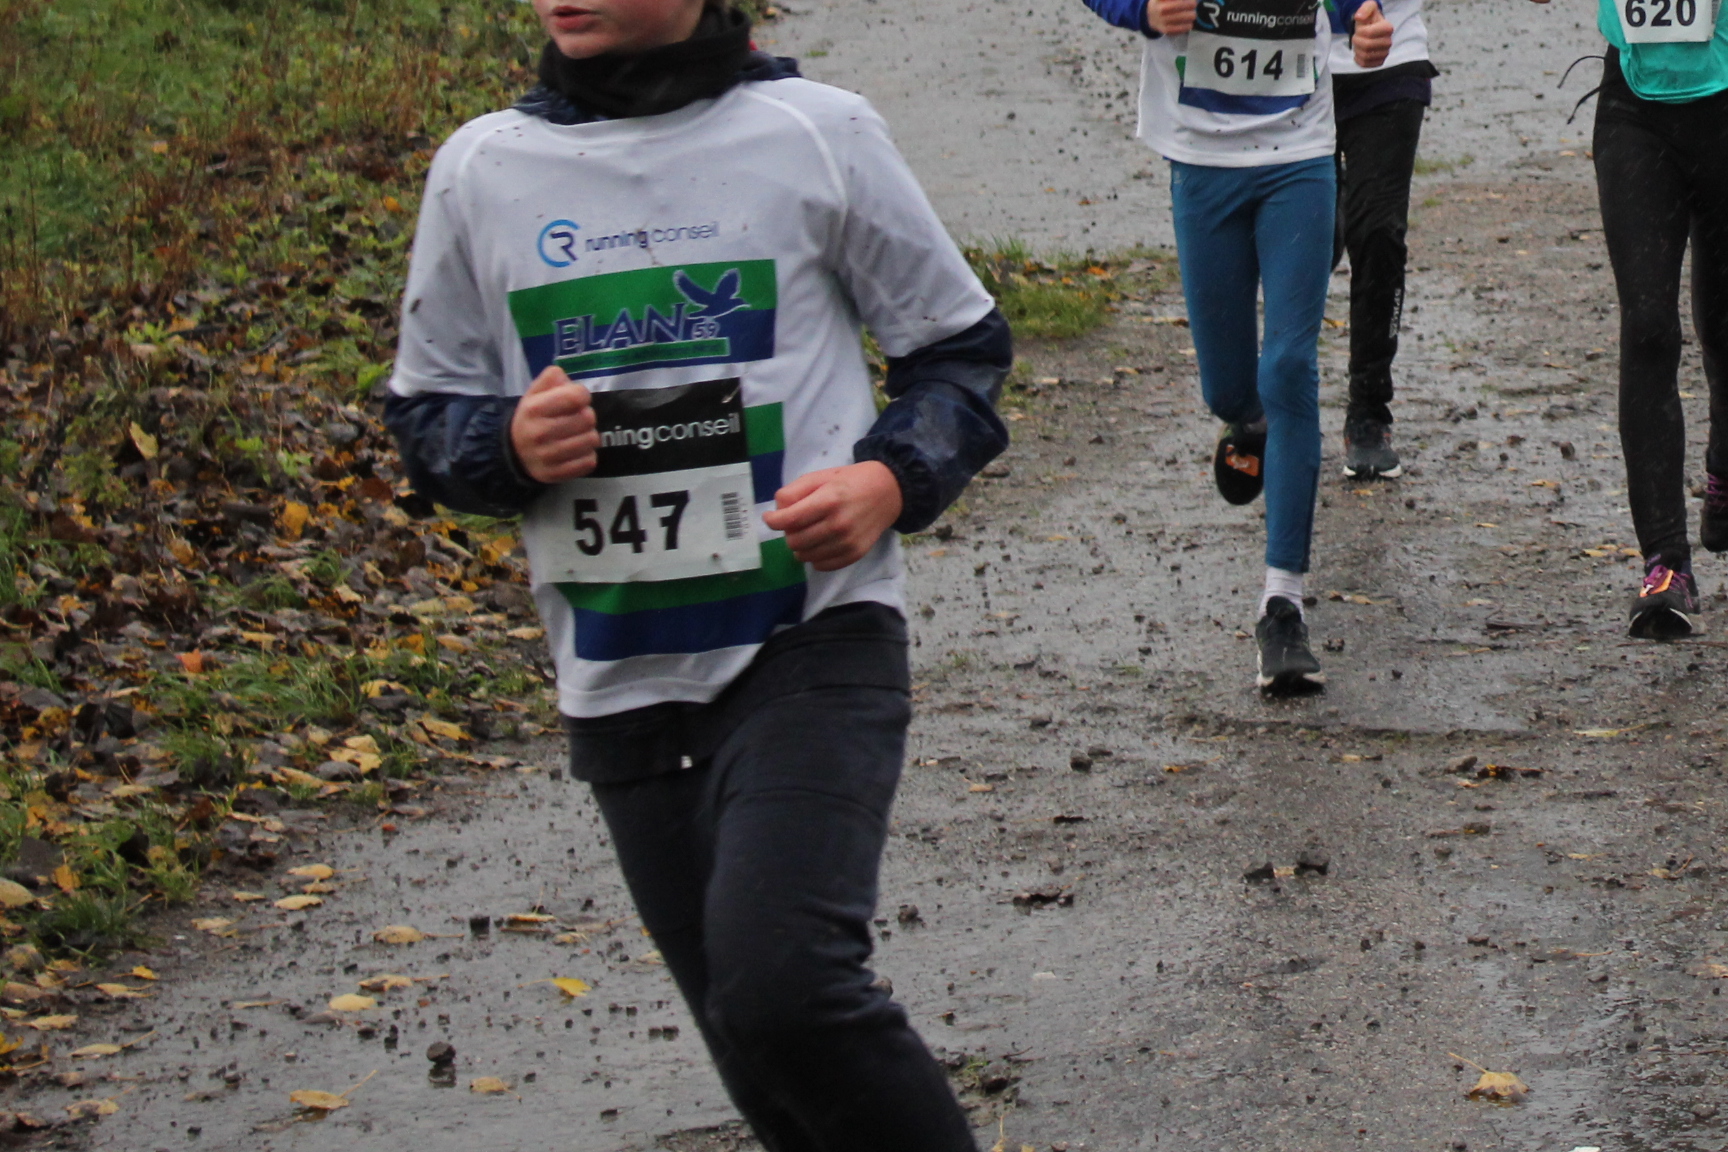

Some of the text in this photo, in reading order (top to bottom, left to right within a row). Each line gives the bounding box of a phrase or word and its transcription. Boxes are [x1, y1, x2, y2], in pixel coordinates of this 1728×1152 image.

[1214, 46, 1284, 80] 614
[553, 302, 687, 359] ELAN
[691, 319, 720, 341] 59
[601, 412, 741, 450] ningconseil
[573, 489, 691, 556] 547
